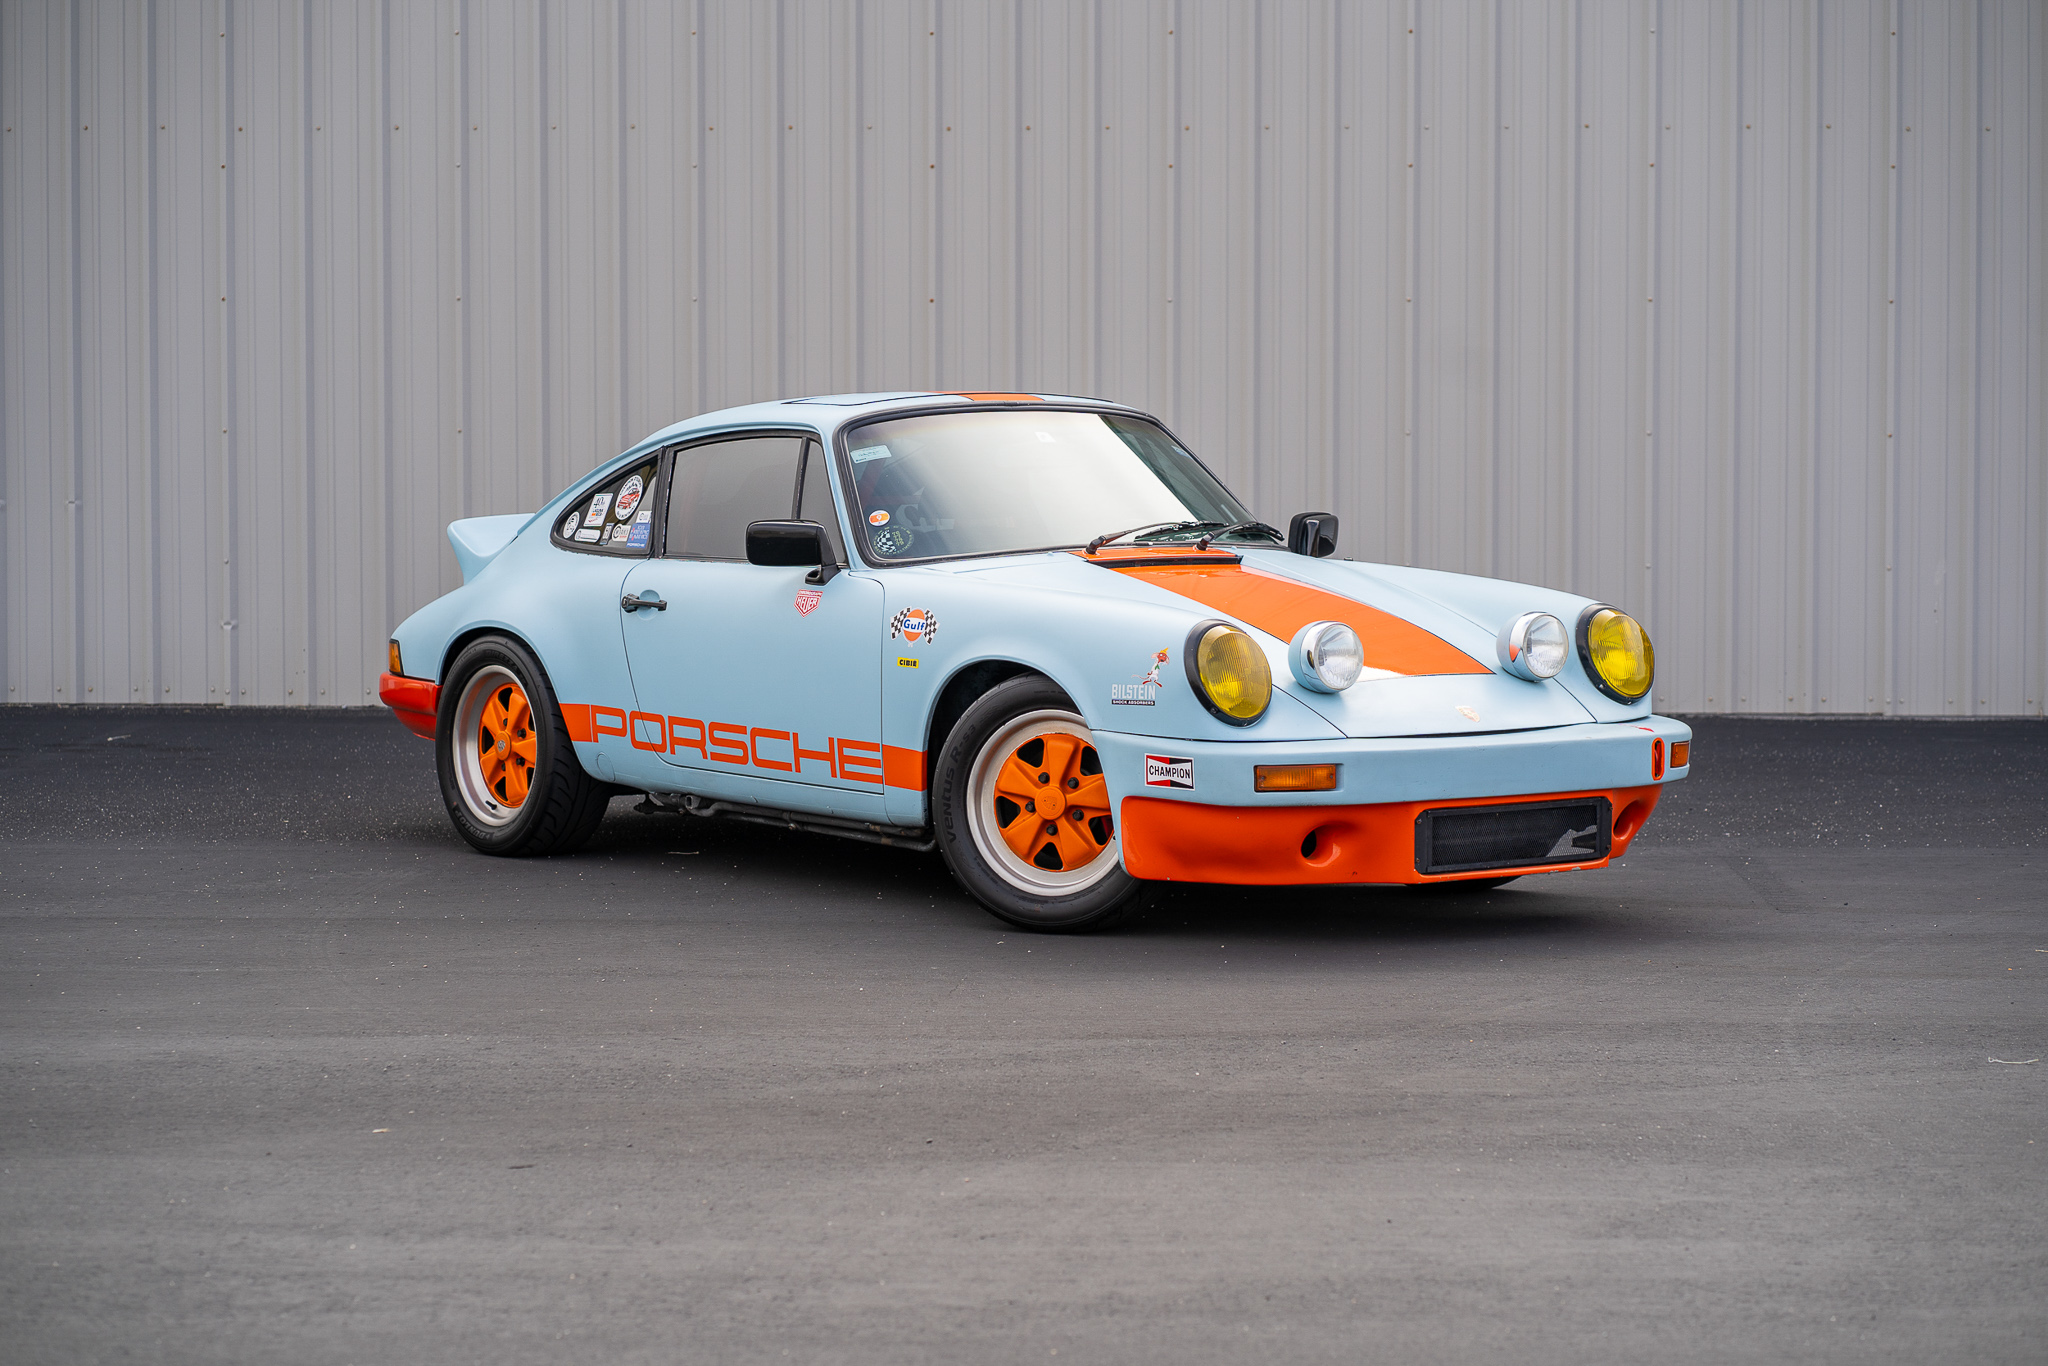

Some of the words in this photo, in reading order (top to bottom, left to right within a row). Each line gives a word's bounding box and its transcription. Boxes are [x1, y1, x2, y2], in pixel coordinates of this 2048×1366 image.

[797, 596, 818, 613] HEUER
[903, 619, 925, 631] Gulf
[1111, 684, 1156, 700] BILSTEIN
[590, 704, 883, 784] PORSCHE
[1148, 765, 1191, 779] CHAMPION
[454, 810, 486, 839] DUNLOP
